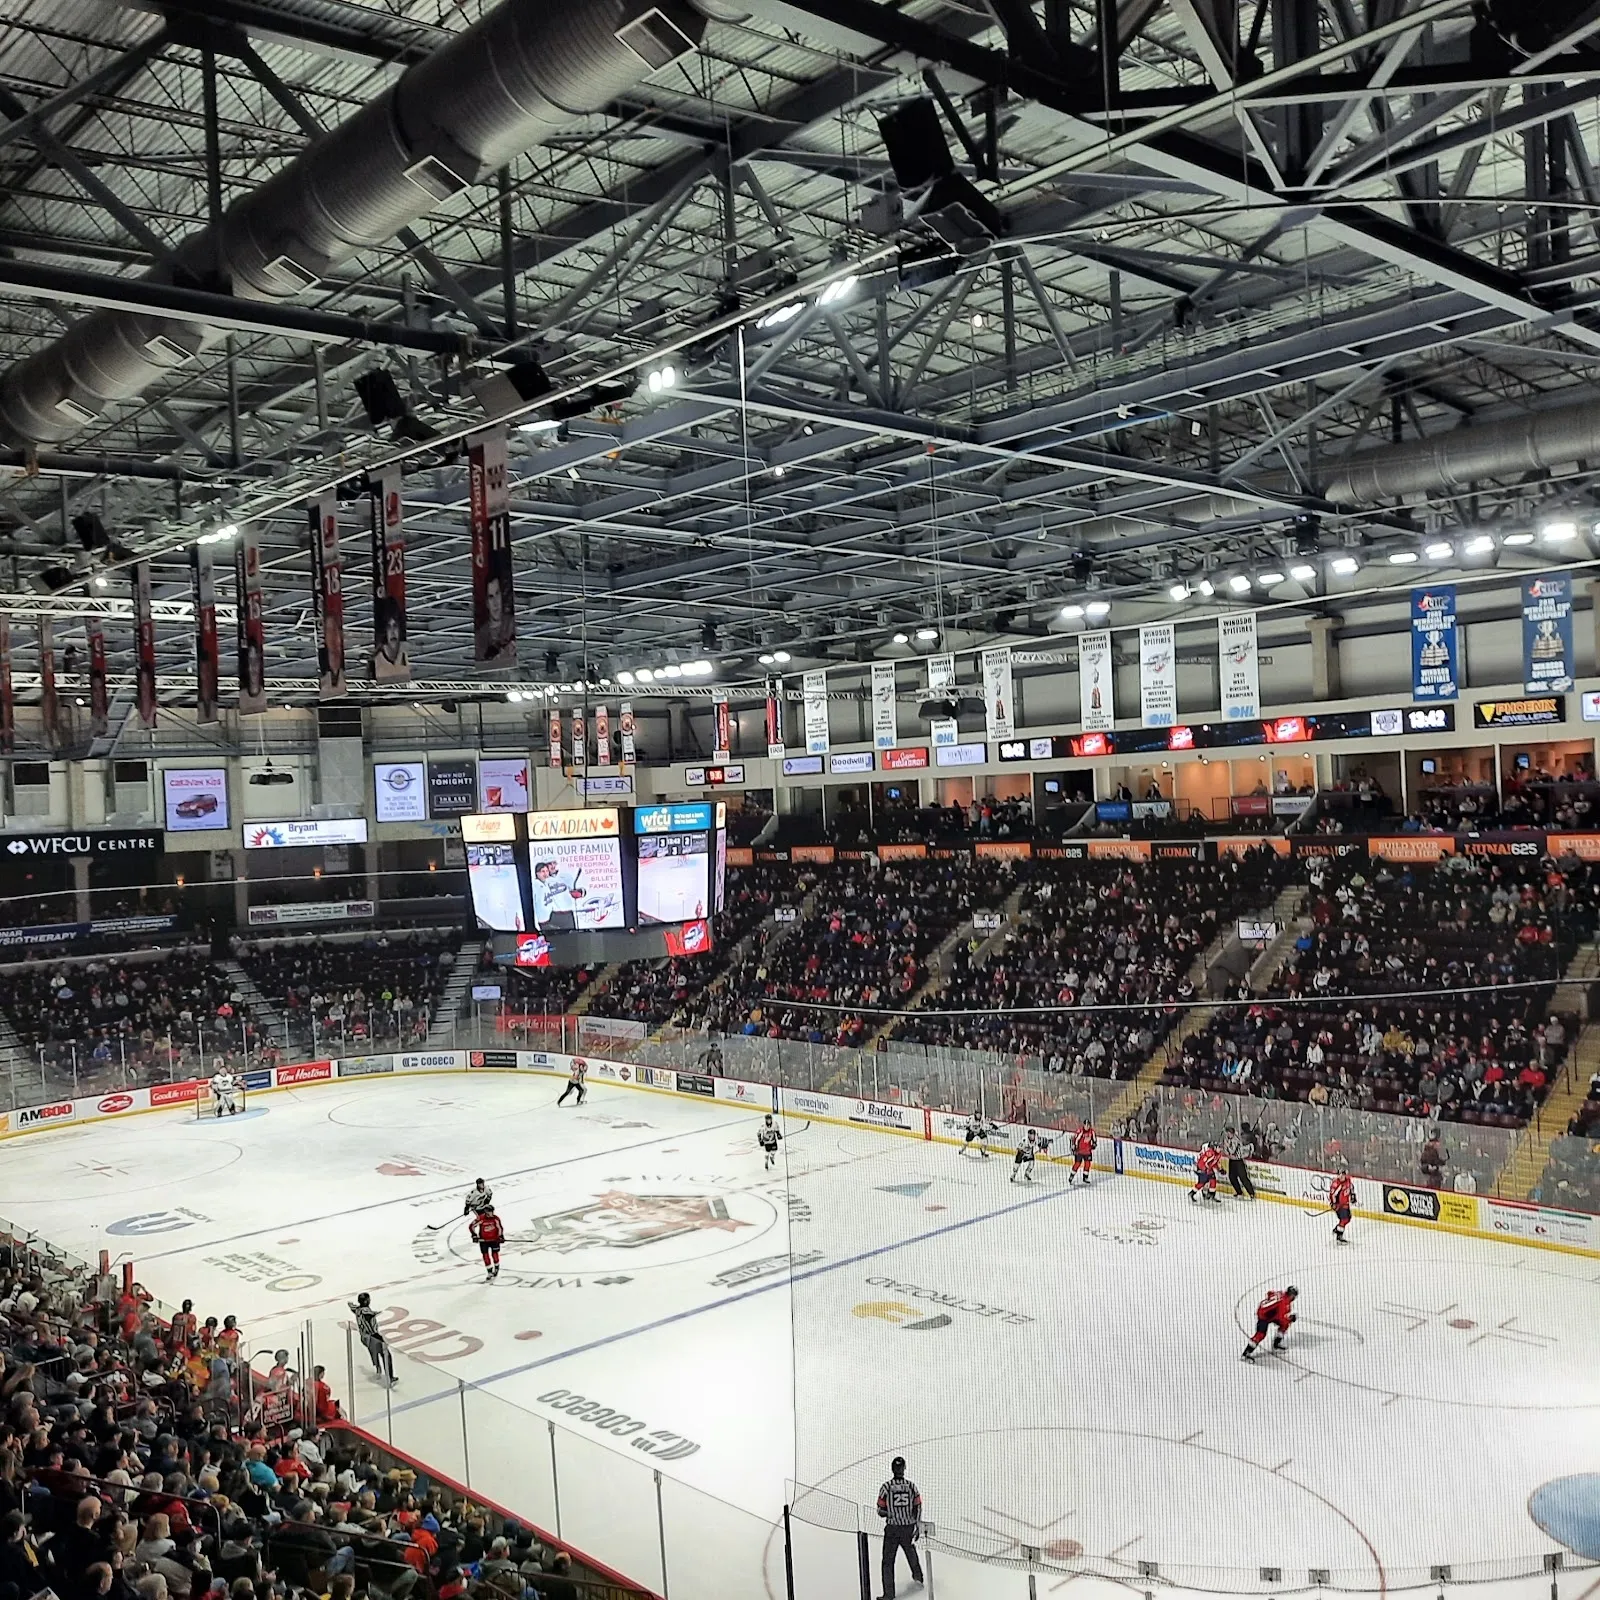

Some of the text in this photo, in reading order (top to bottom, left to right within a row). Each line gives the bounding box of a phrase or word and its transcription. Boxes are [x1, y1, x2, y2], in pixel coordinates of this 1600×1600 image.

[489, 518, 506, 550] 11
[387, 549, 403, 575] 23
[325, 567, 340, 595] 18
[1223, 618, 1252, 627] WINDSOR
[1144, 629, 1170, 637] WINDSOR
[1223, 626, 1253, 636] SPITFIRES
[1082, 635, 1107, 643] WINDSOR
[1144, 637, 1171, 646] SPITFIRES
[1082, 643, 1108, 651] SPITFIRES
[985, 651, 1007, 659] WINDSOR
[986, 658, 1008, 666] SPITFIRES
[1229, 705, 1255, 718] OHL
[1496, 699, 1557, 715] PHOENIX
[1149, 713, 1172, 724] OHL
[1499, 713, 1555, 723] JEWELLERS
[936, 734, 954, 743] OHL
[831, 756, 865, 767] Goodwill
[431, 778, 473, 786] TONIGHT?
[641, 808, 671, 828] wfcu
[288, 822, 318, 833] Bryant
[533, 817, 599, 836] CANADIAN
[29, 836, 155, 853] WFCU CENTRE
[1378, 841, 1438, 850] BUILD YOUR
[1559, 840, 1593, 848] BUILD
[533, 843, 614, 857] JOIN OUR FAMILY
[1379, 850, 1417, 858] CAREER
[560, 854, 610, 863] INTERESTED
[278, 1066, 330, 1083] Tim Hortons
[152, 1088, 179, 1101] GoodLife
[19, 1103, 73, 1123] AM800
[868, 1104, 904, 1120] Badder
[1136, 1147, 1164, 1161] What's
[1139, 1160, 1192, 1174] POPCORN FACTORY
[1302, 1191, 1325, 1202] Audi
[224, 1253, 282, 1277] COLLEGE
[249, 1251, 302, 1271] ALUMNI
[893, 1493, 909, 1507] 25
